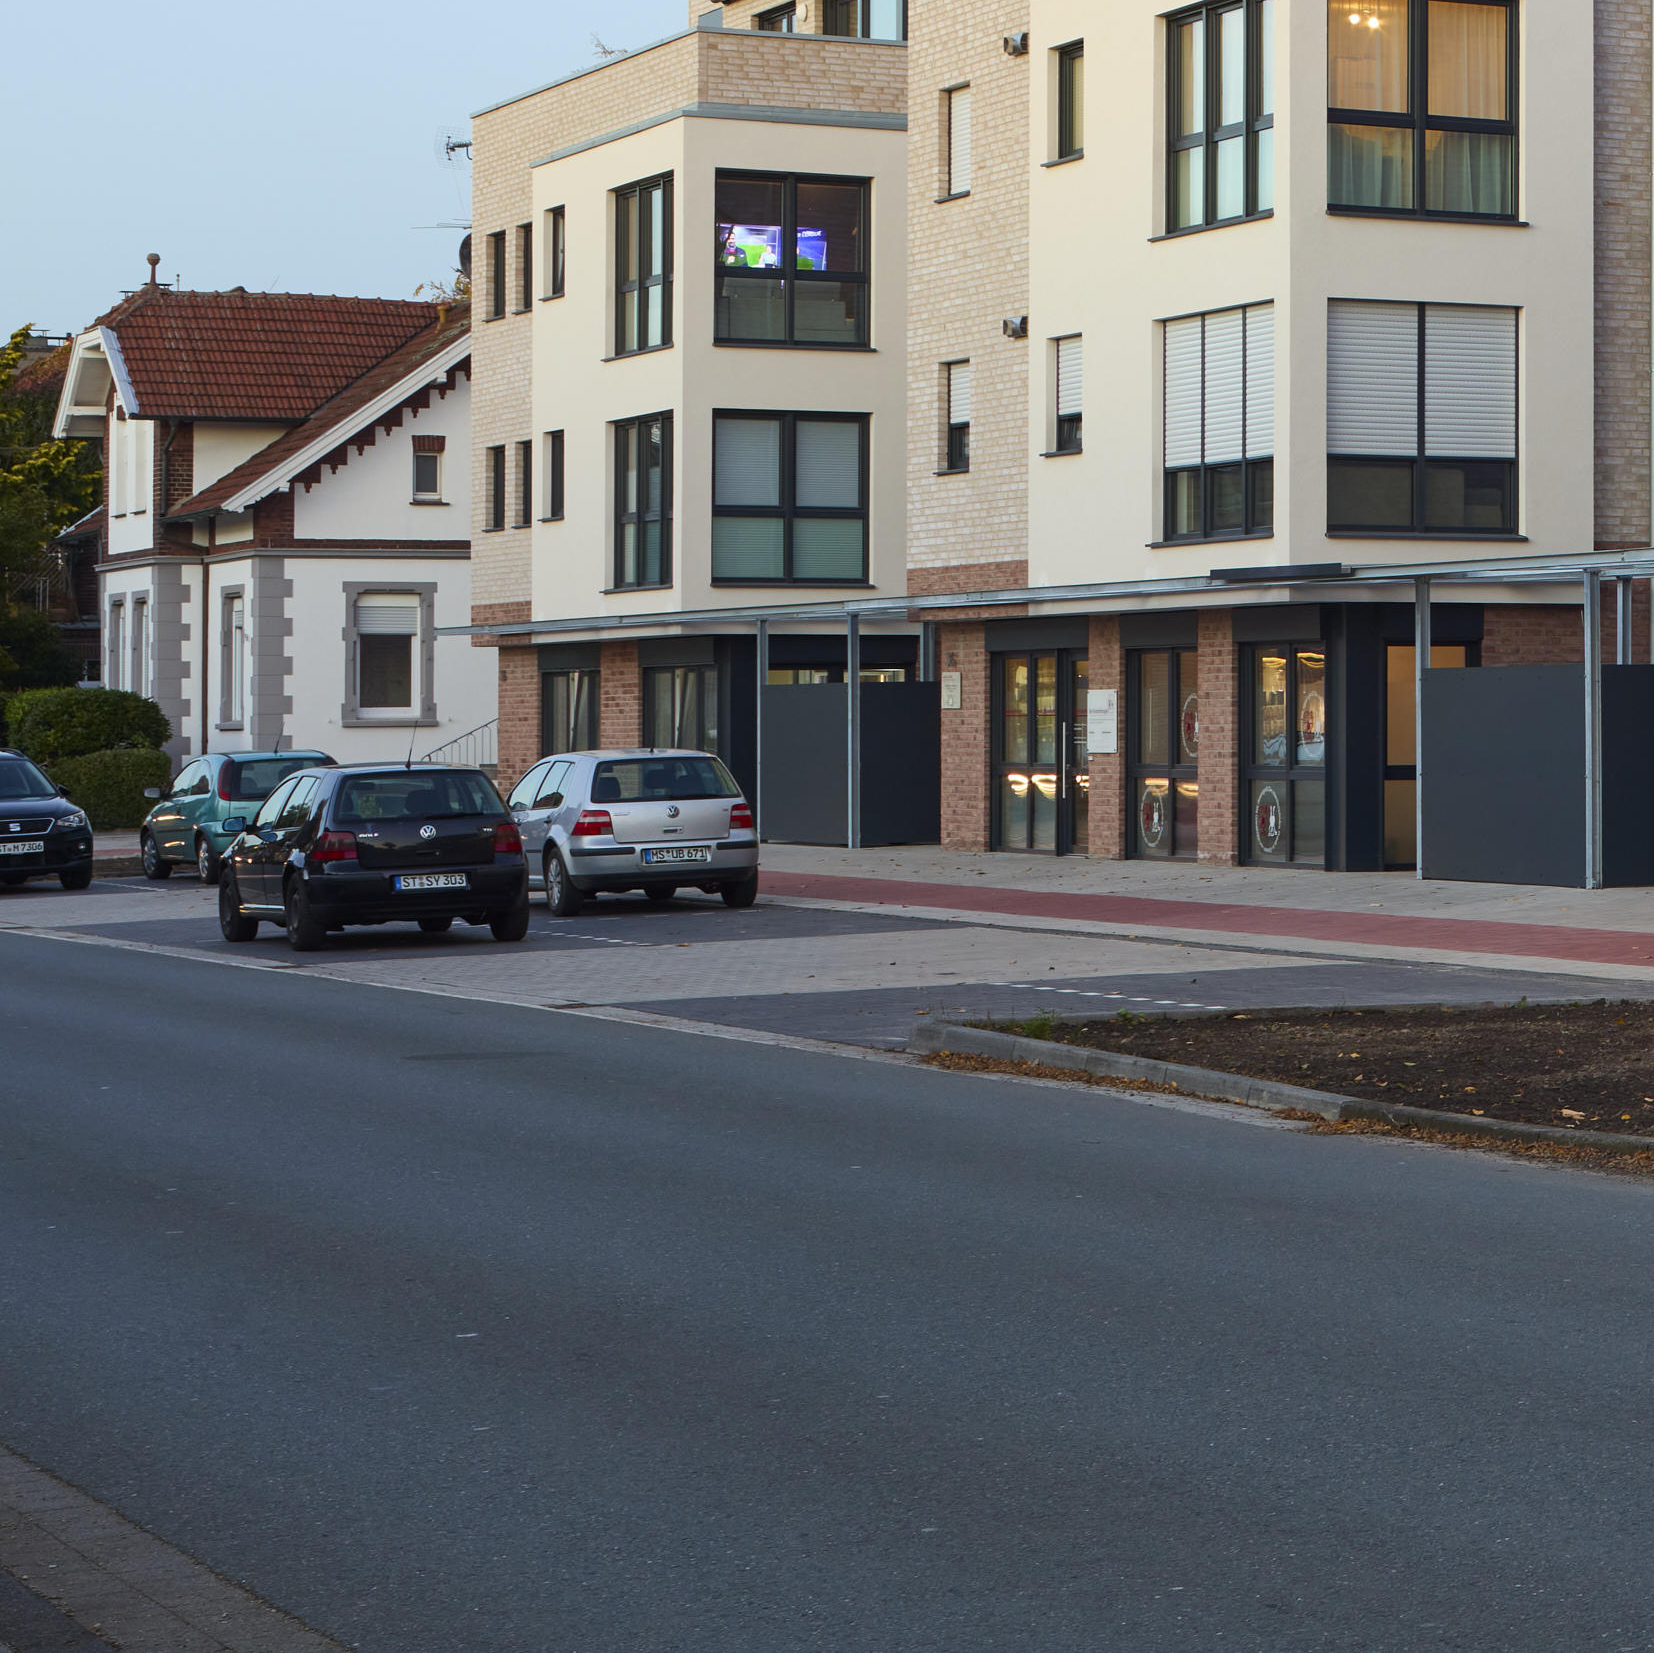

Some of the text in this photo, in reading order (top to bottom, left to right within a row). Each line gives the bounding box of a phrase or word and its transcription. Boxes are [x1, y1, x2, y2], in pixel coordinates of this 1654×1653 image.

[21, 843, 43, 851] 7306
[651, 848, 705, 860] MS UB 671
[402, 874, 465, 888] ST SY 303
